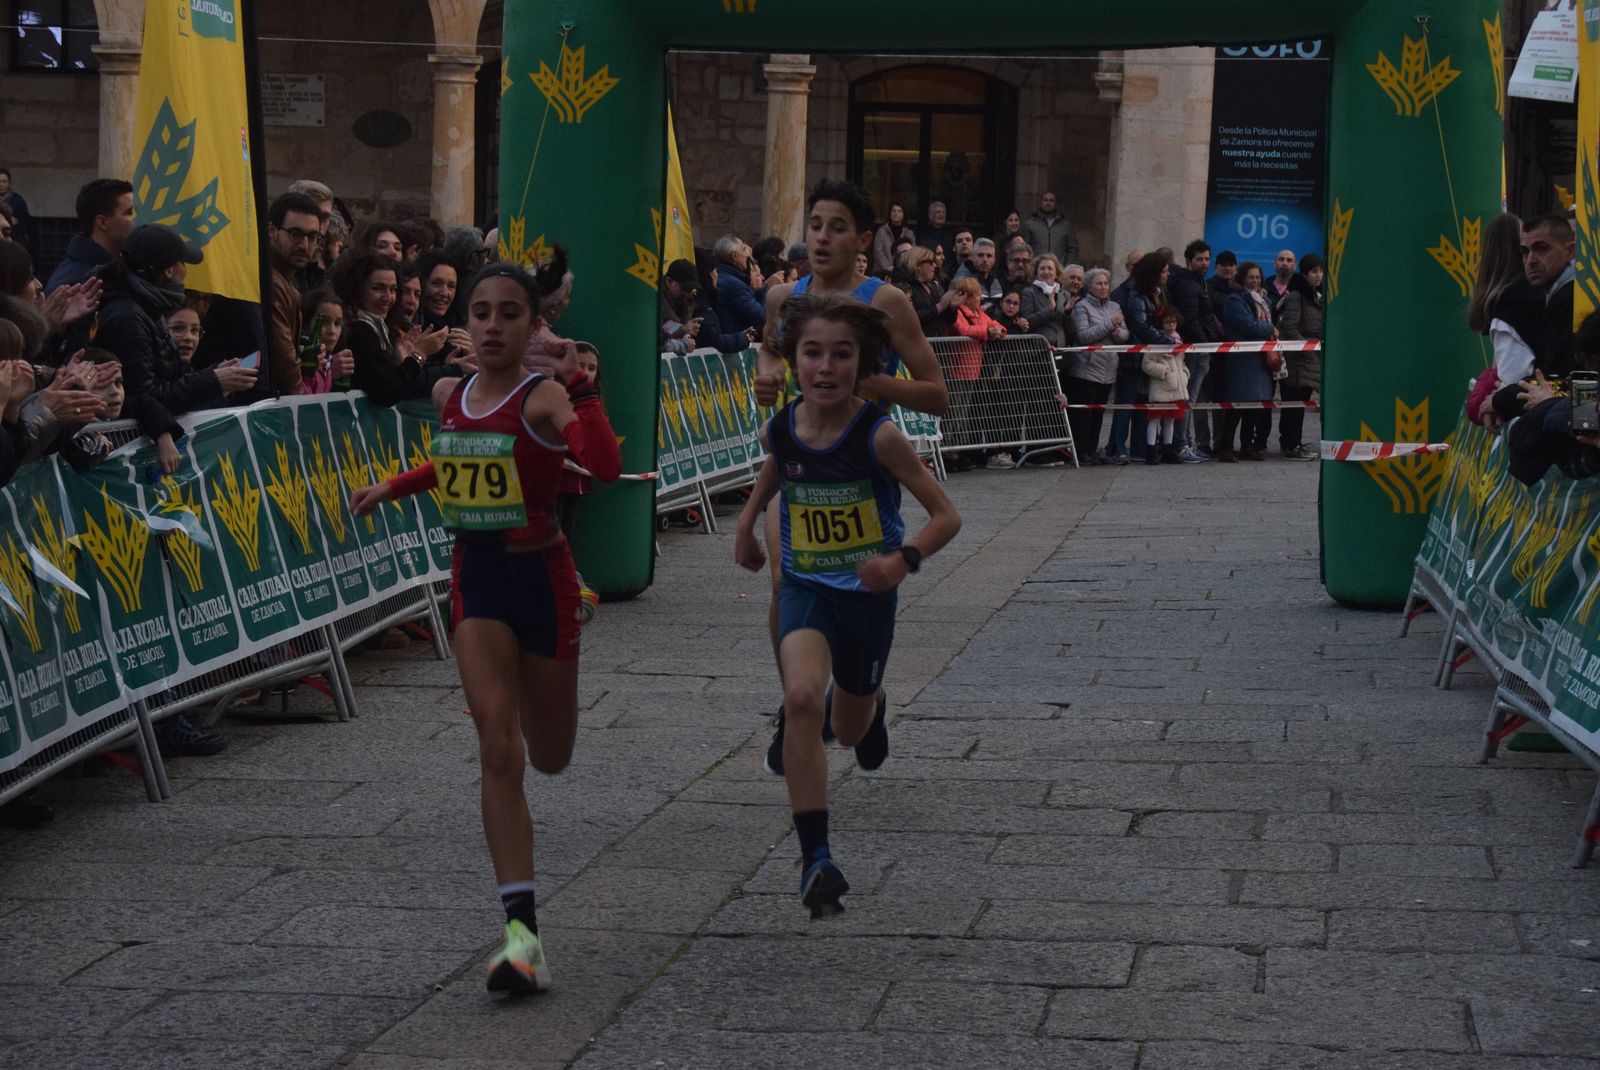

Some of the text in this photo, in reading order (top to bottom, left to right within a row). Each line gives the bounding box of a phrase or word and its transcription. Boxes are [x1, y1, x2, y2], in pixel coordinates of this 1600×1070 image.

[1218, 126, 1244, 136] Desde
[1244, 126, 1252, 136] la
[1279, 127, 1318, 138] Municipal
[1219, 137, 1315, 149] de Zamora te ofrecemos
[1222, 149, 1312, 159] nuestra ayuda cuando
[1234, 160, 1298, 170] más la necesitas
[1237, 213, 1290, 240] 016
[442, 462, 508, 499] 279
[459, 511, 522, 523] CAJA RURAL
[800, 506, 865, 544] 1051
[816, 555, 842, 567] CAJA
[112, 615, 171, 655] AJA RURAL
